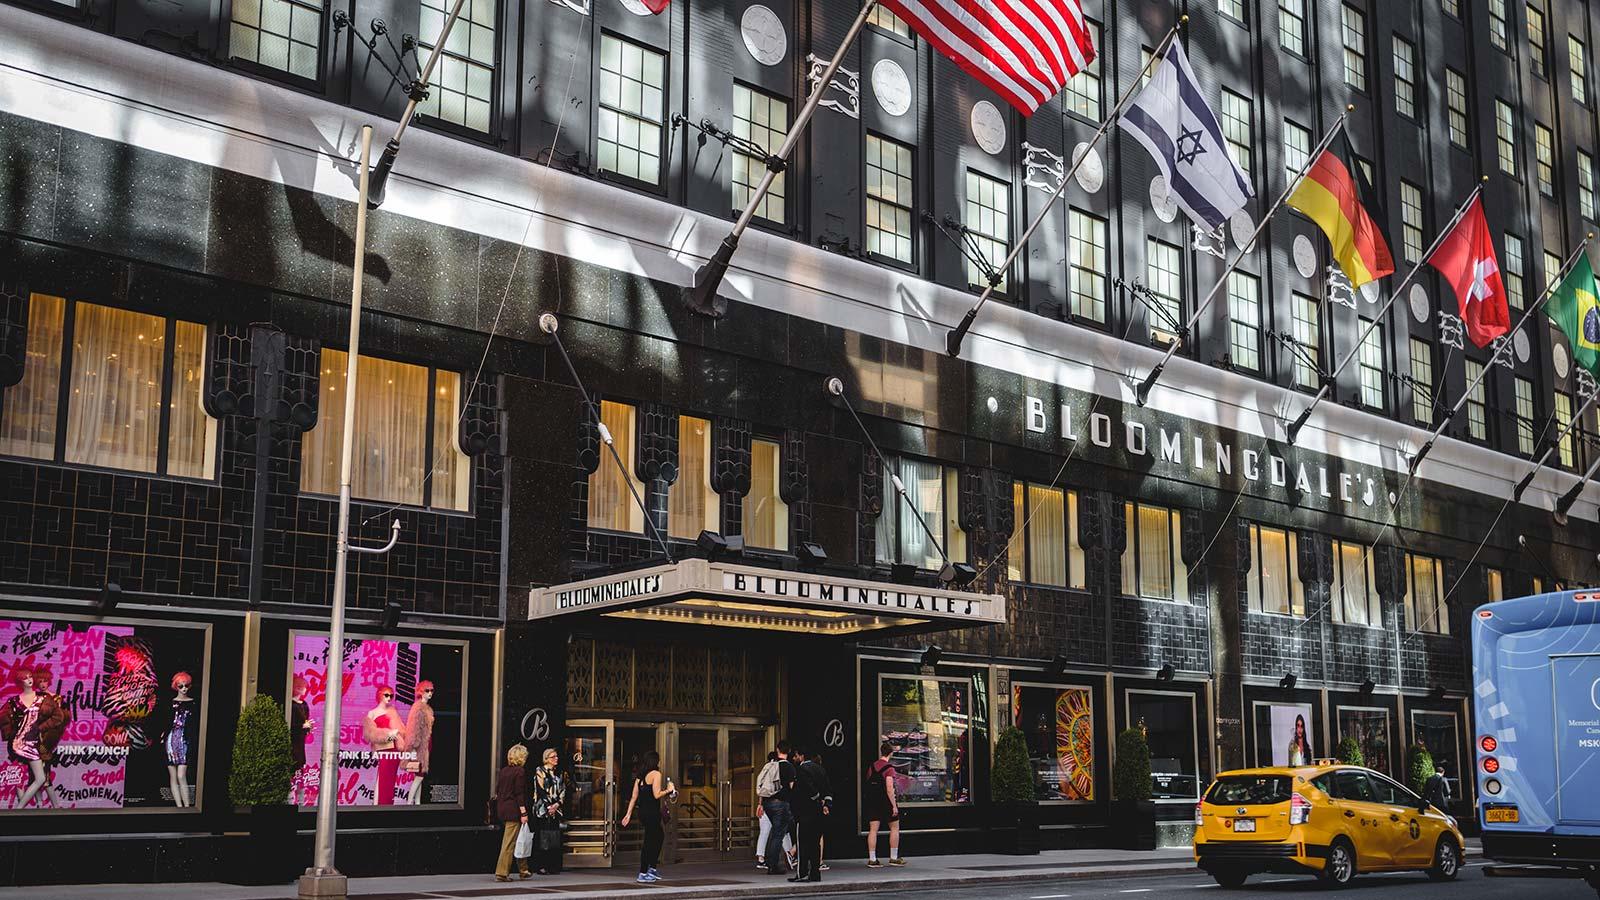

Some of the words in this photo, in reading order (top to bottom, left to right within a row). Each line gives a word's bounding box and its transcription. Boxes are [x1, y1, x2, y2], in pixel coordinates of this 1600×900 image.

[1025, 395, 1376, 507] BLOOMINGDALE'S
[560, 574, 660, 608] BLOOMINGDALE'S
[520, 708, 550, 741] B
[823, 719, 844, 747] B
[57, 745, 86, 755] PINK
[88, 746, 129, 755] PUNCH
[361, 751, 371, 760] IS
[372, 751, 417, 760] ATTITUDE
[54, 783, 124, 806] PHENOMENAL
